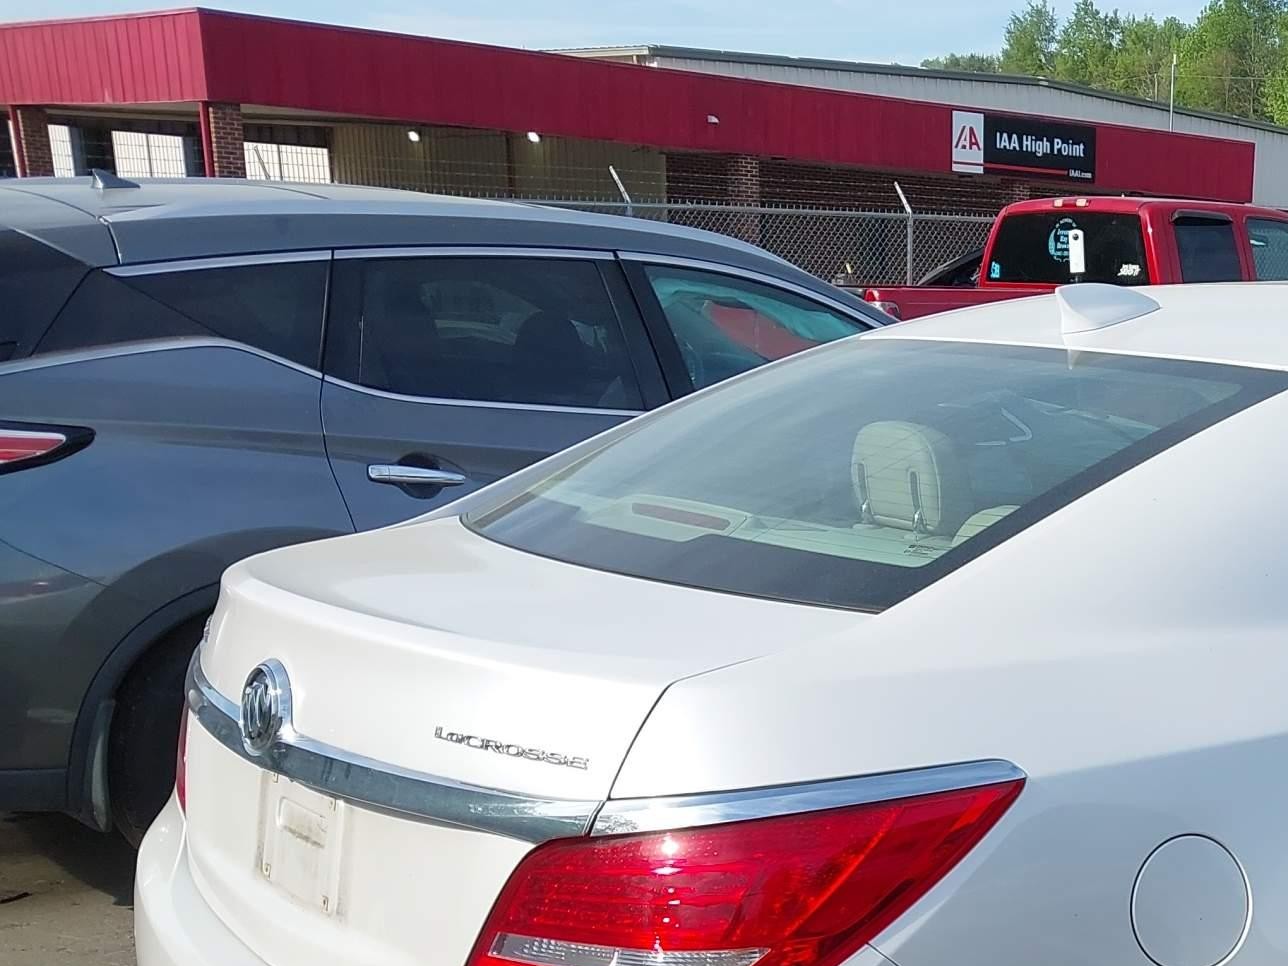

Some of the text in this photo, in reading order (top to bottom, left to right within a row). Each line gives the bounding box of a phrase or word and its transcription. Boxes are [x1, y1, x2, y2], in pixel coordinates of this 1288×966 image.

[996, 132, 1085, 157] IAA High Point
